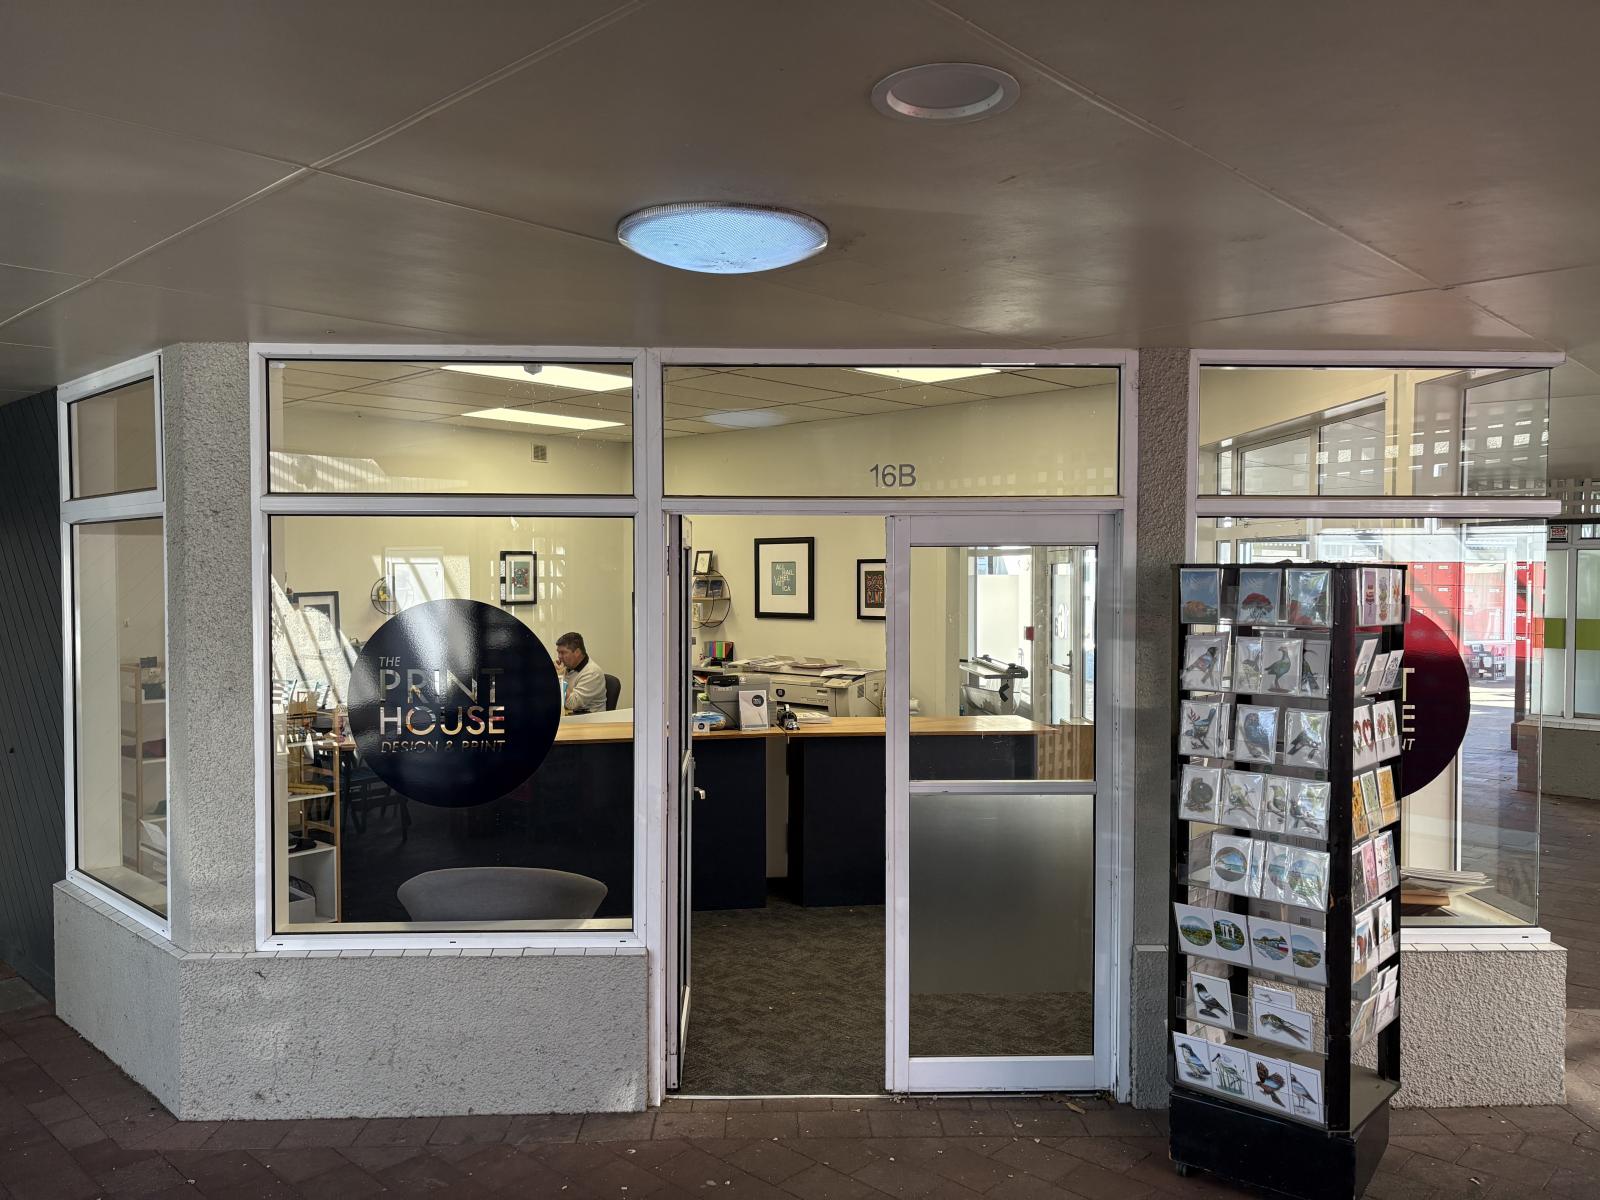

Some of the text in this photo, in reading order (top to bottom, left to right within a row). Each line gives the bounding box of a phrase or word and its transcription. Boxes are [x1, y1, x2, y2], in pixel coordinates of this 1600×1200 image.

[869, 463, 917, 488] 16B
[379, 656, 401, 667] THE
[380, 668, 504, 704] PRINT
[380, 705, 505, 736] HOUSE
[381, 740, 439, 753] DESIGN
[462, 740, 506, 752] PRINT
